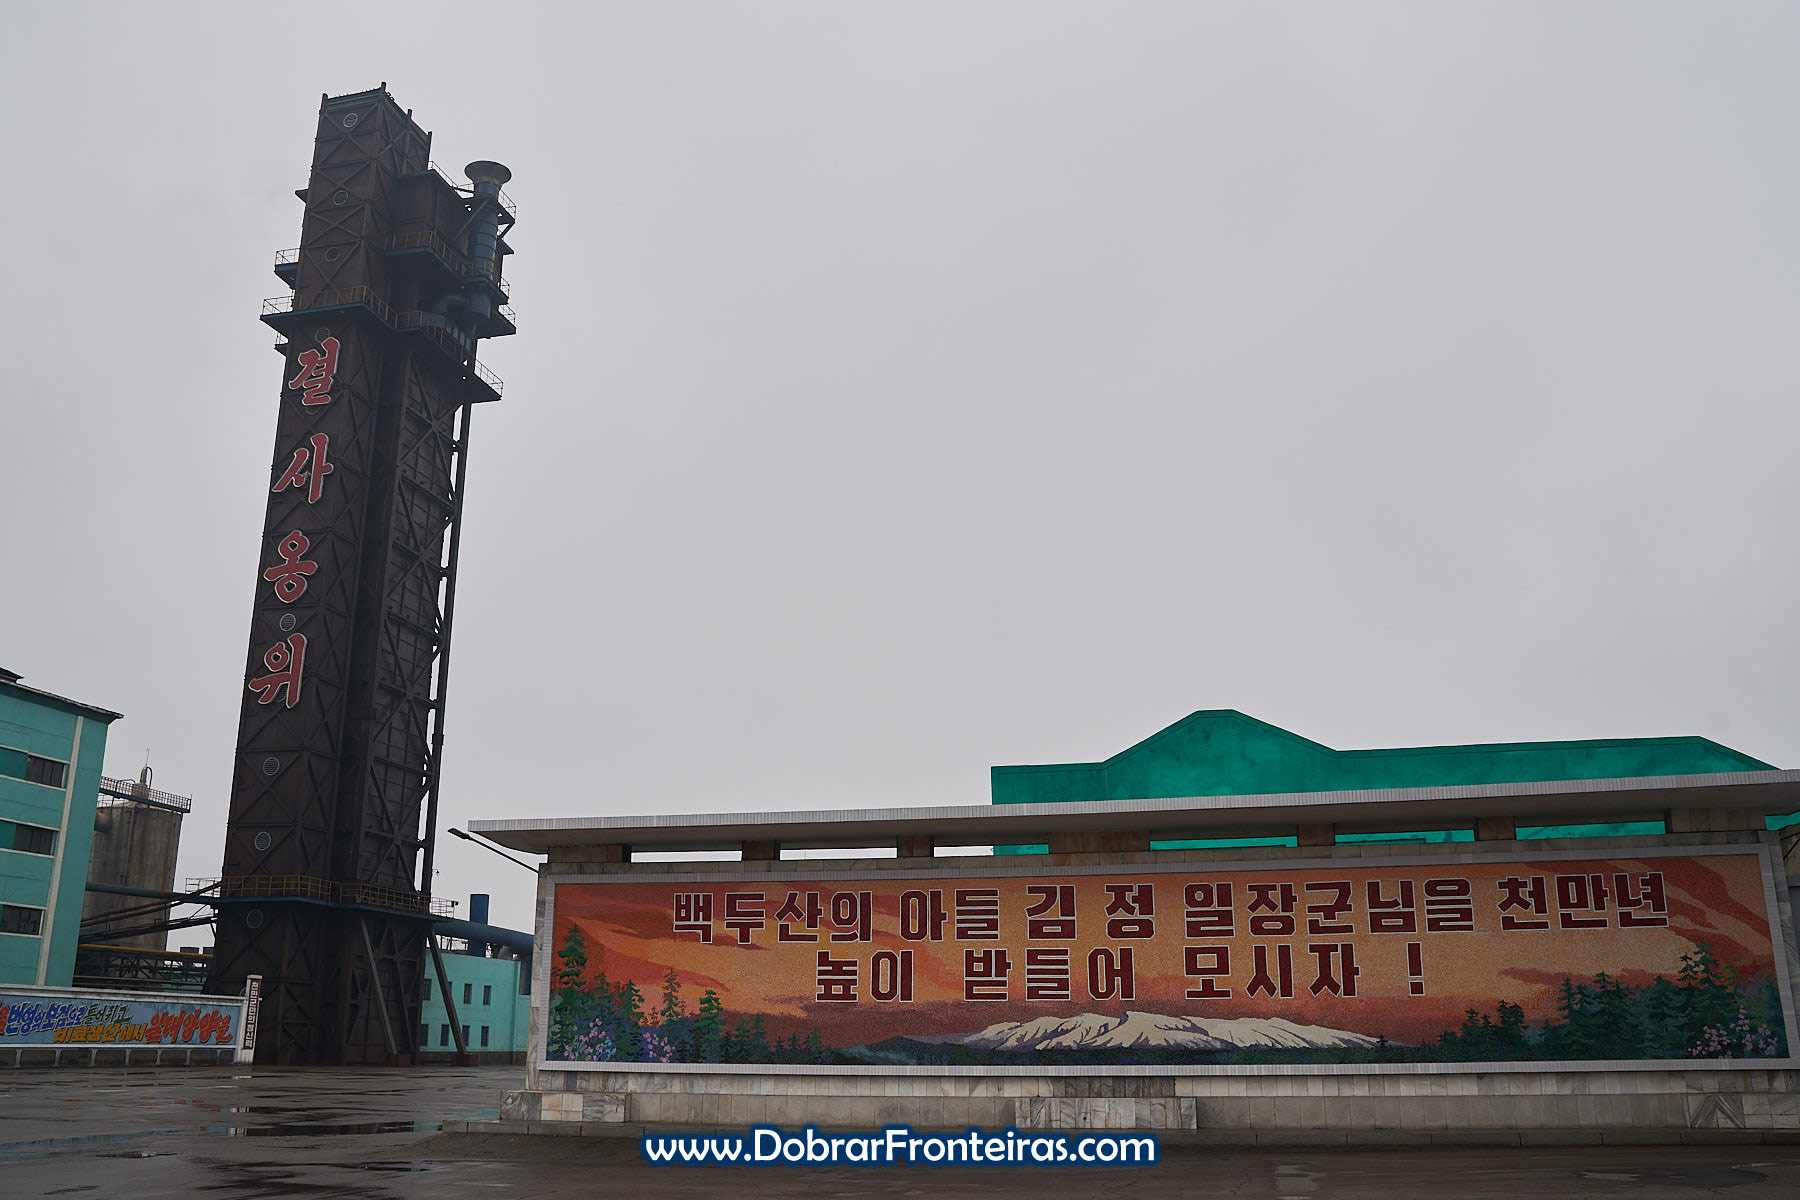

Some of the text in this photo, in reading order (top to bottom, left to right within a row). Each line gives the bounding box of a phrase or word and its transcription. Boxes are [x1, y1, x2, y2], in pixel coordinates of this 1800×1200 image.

[673, 890, 873, 944] 백두산의
[899, 887, 1001, 942] 아들
[1496, 871, 1670, 932] 천만년
[815, 949, 914, 1003] 높이
[963, 946, 1136, 1002] 받들어
